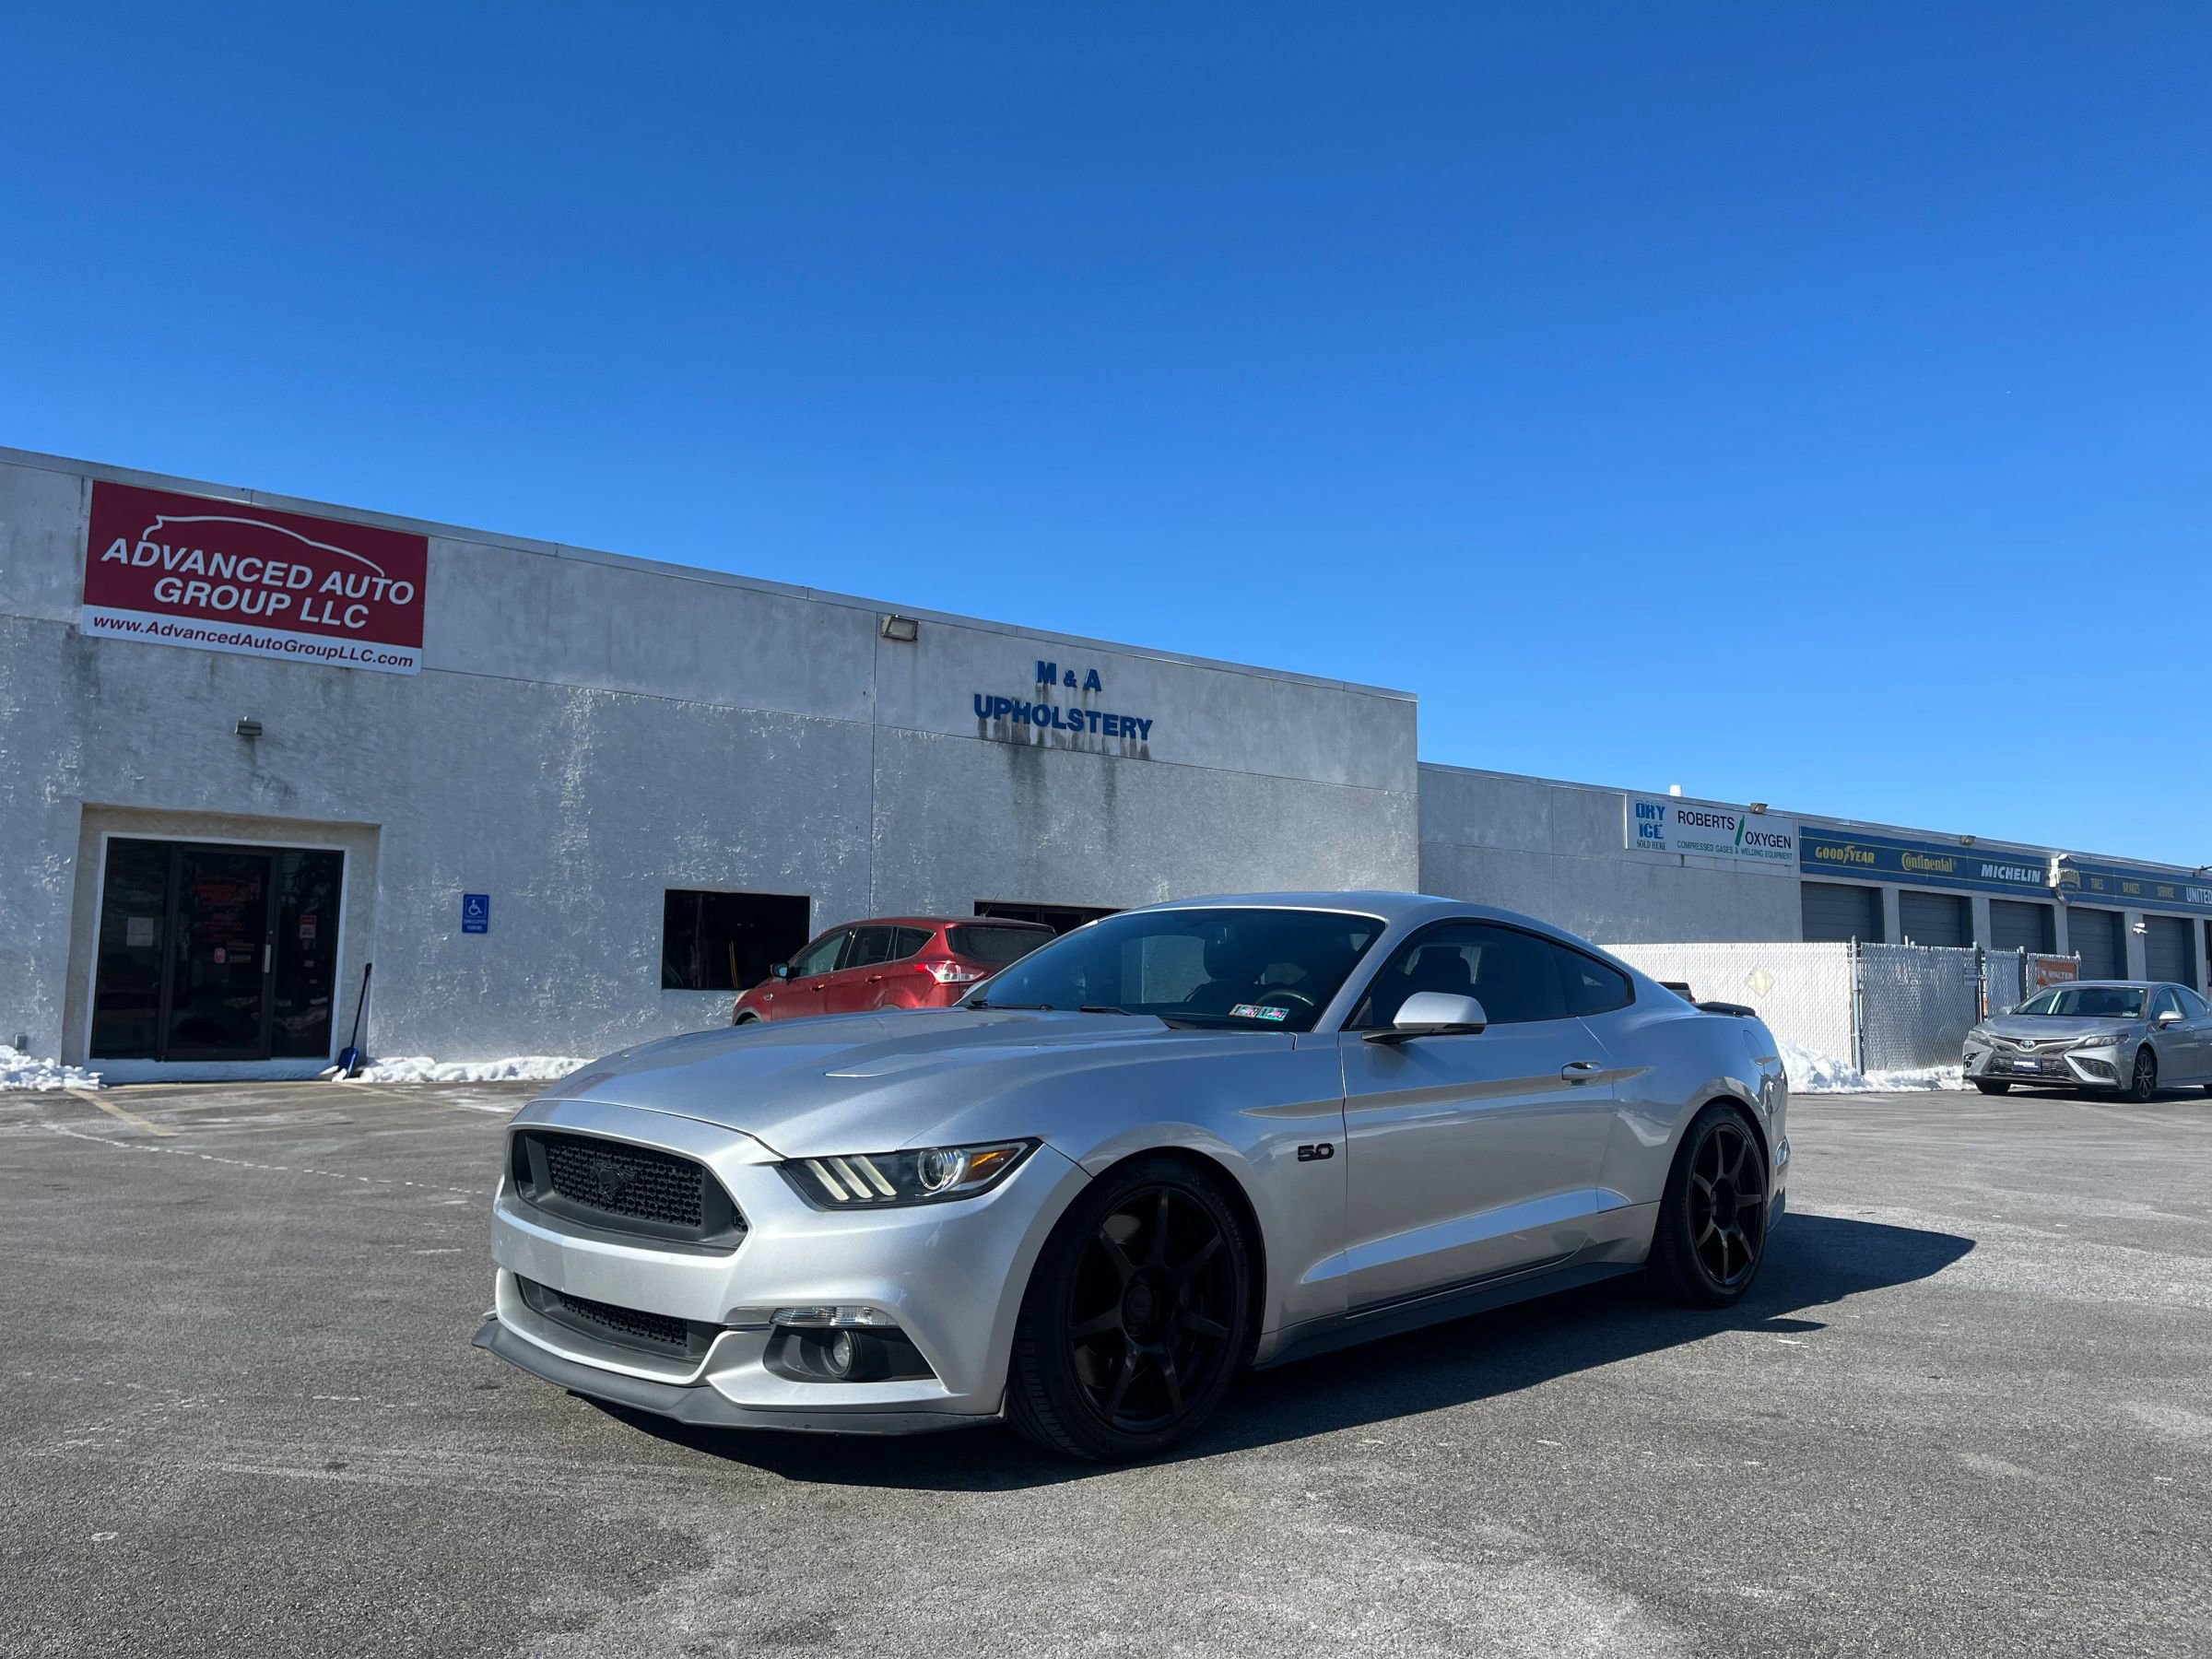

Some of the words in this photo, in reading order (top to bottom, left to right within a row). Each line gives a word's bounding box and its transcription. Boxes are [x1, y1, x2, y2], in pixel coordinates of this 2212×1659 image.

[101, 537, 313, 590] ADVANCED
[319, 571, 415, 606] AUTO
[153, 576, 291, 617] GROUP
[300, 601, 370, 629] LLC
[93, 615, 414, 668] www.AdvancedAutoGroupLLC.com
[1035, 661, 1057, 685] M
[1063, 670, 1077, 688] &
[1083, 669, 1101, 691] A
[973, 693, 1153, 741] UPHOLSTERY
[1635, 802, 1665, 820] DRY
[1677, 810, 1735, 830] ROBERTS
[1639, 822, 1665, 839] ICE
[1745, 831, 1792, 850] OXYGEN
[1636, 840, 1652, 849] SOLD
[1652, 841, 1666, 851] HERE
[1677, 840, 1713, 852] COMPRESSED
[1715, 844, 1733, 854] GASES
[1741, 847, 1763, 857] WELDING
[1765, 850, 1793, 861] EQUIPMENT
[1815, 845, 1875, 865] GOODYEAR
[1901, 853, 1953, 873] Continental
[1981, 864, 2041, 883] MICHELIN
